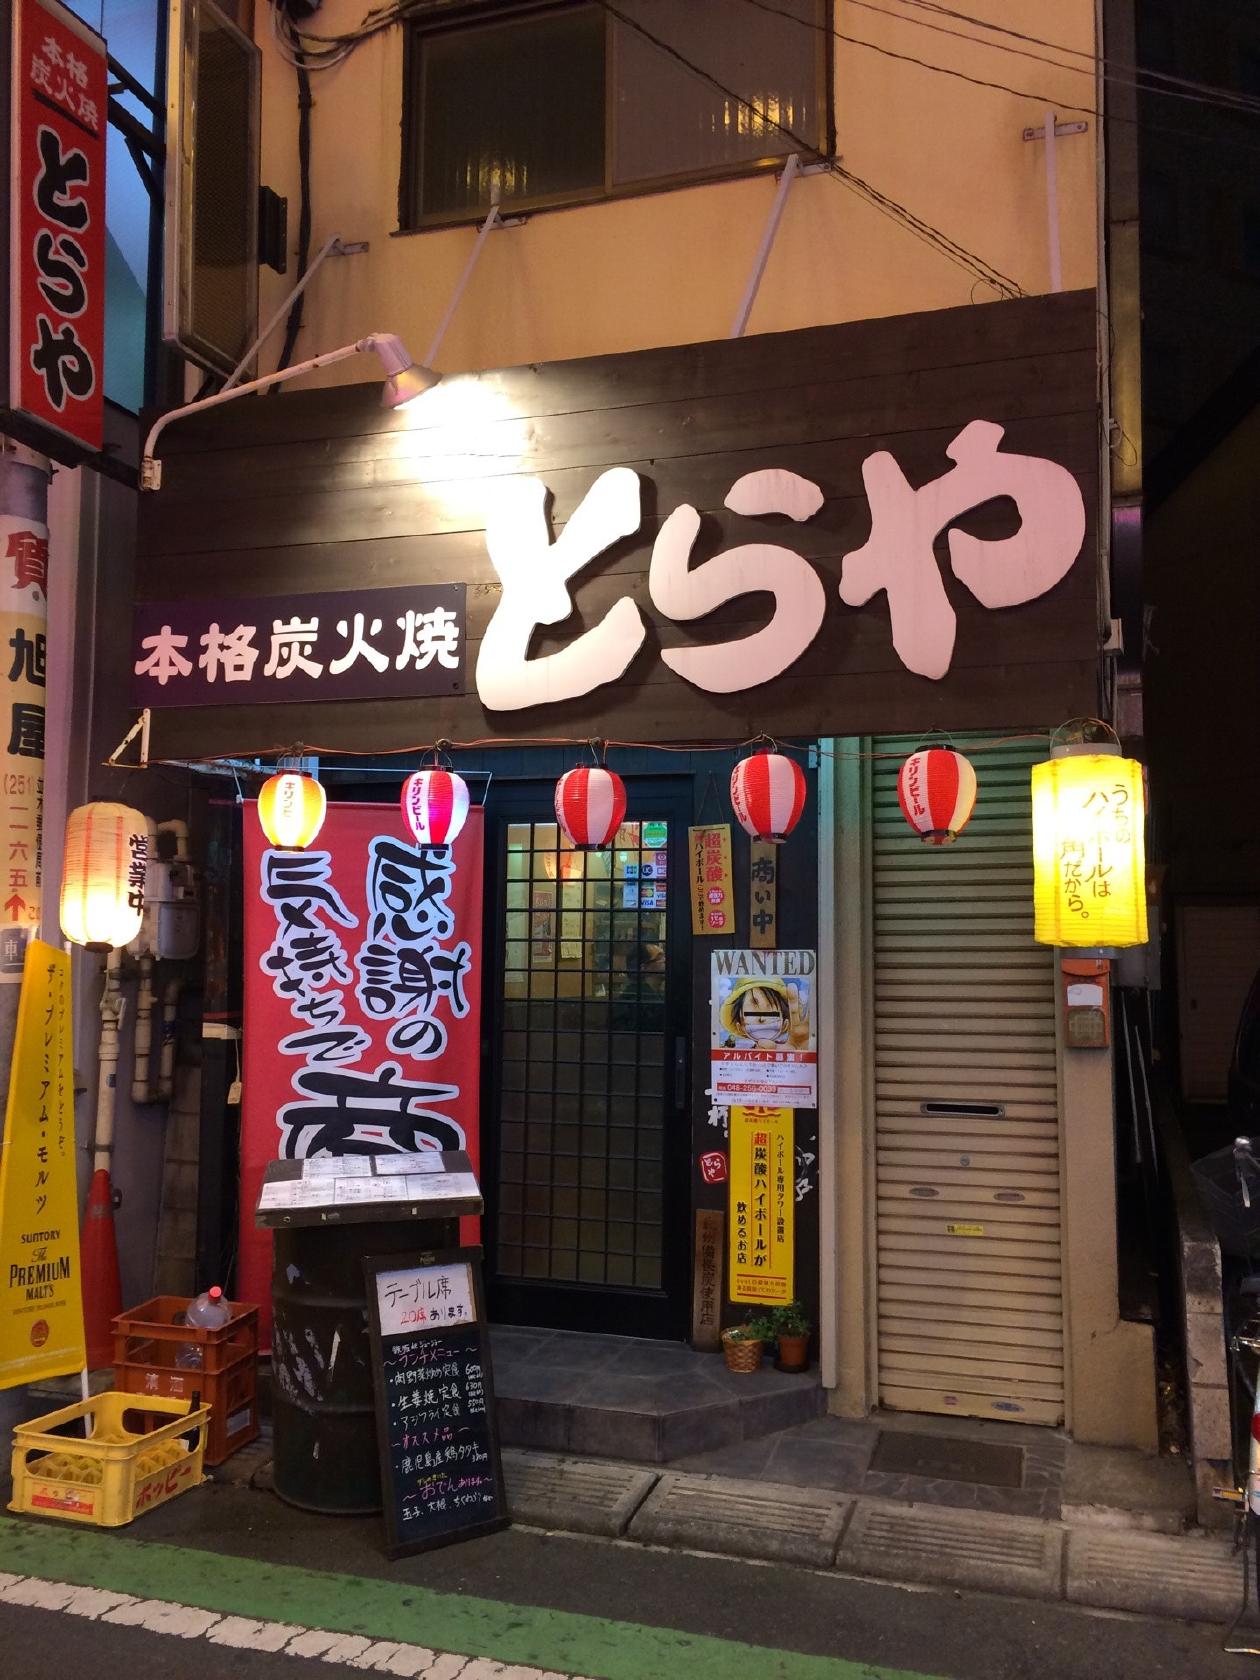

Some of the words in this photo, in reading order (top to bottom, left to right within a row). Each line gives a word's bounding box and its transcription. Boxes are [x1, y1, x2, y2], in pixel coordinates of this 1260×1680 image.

[30, 124, 96, 413] とらや
[475, 419, 1087, 711] とらや
[134, 606, 460, 685] 本格炭火焼
[412, 778, 425, 831] キリンビール
[715, 950, 816, 976] WANTED
[753, 1132, 767, 1267] 超炭酸ハイボールが
[736, 1202, 747, 1264] 飲めるお店
[10, 1256, 71, 1288] PREMIUM
[385, 1275, 452, 1308] テーブル席
